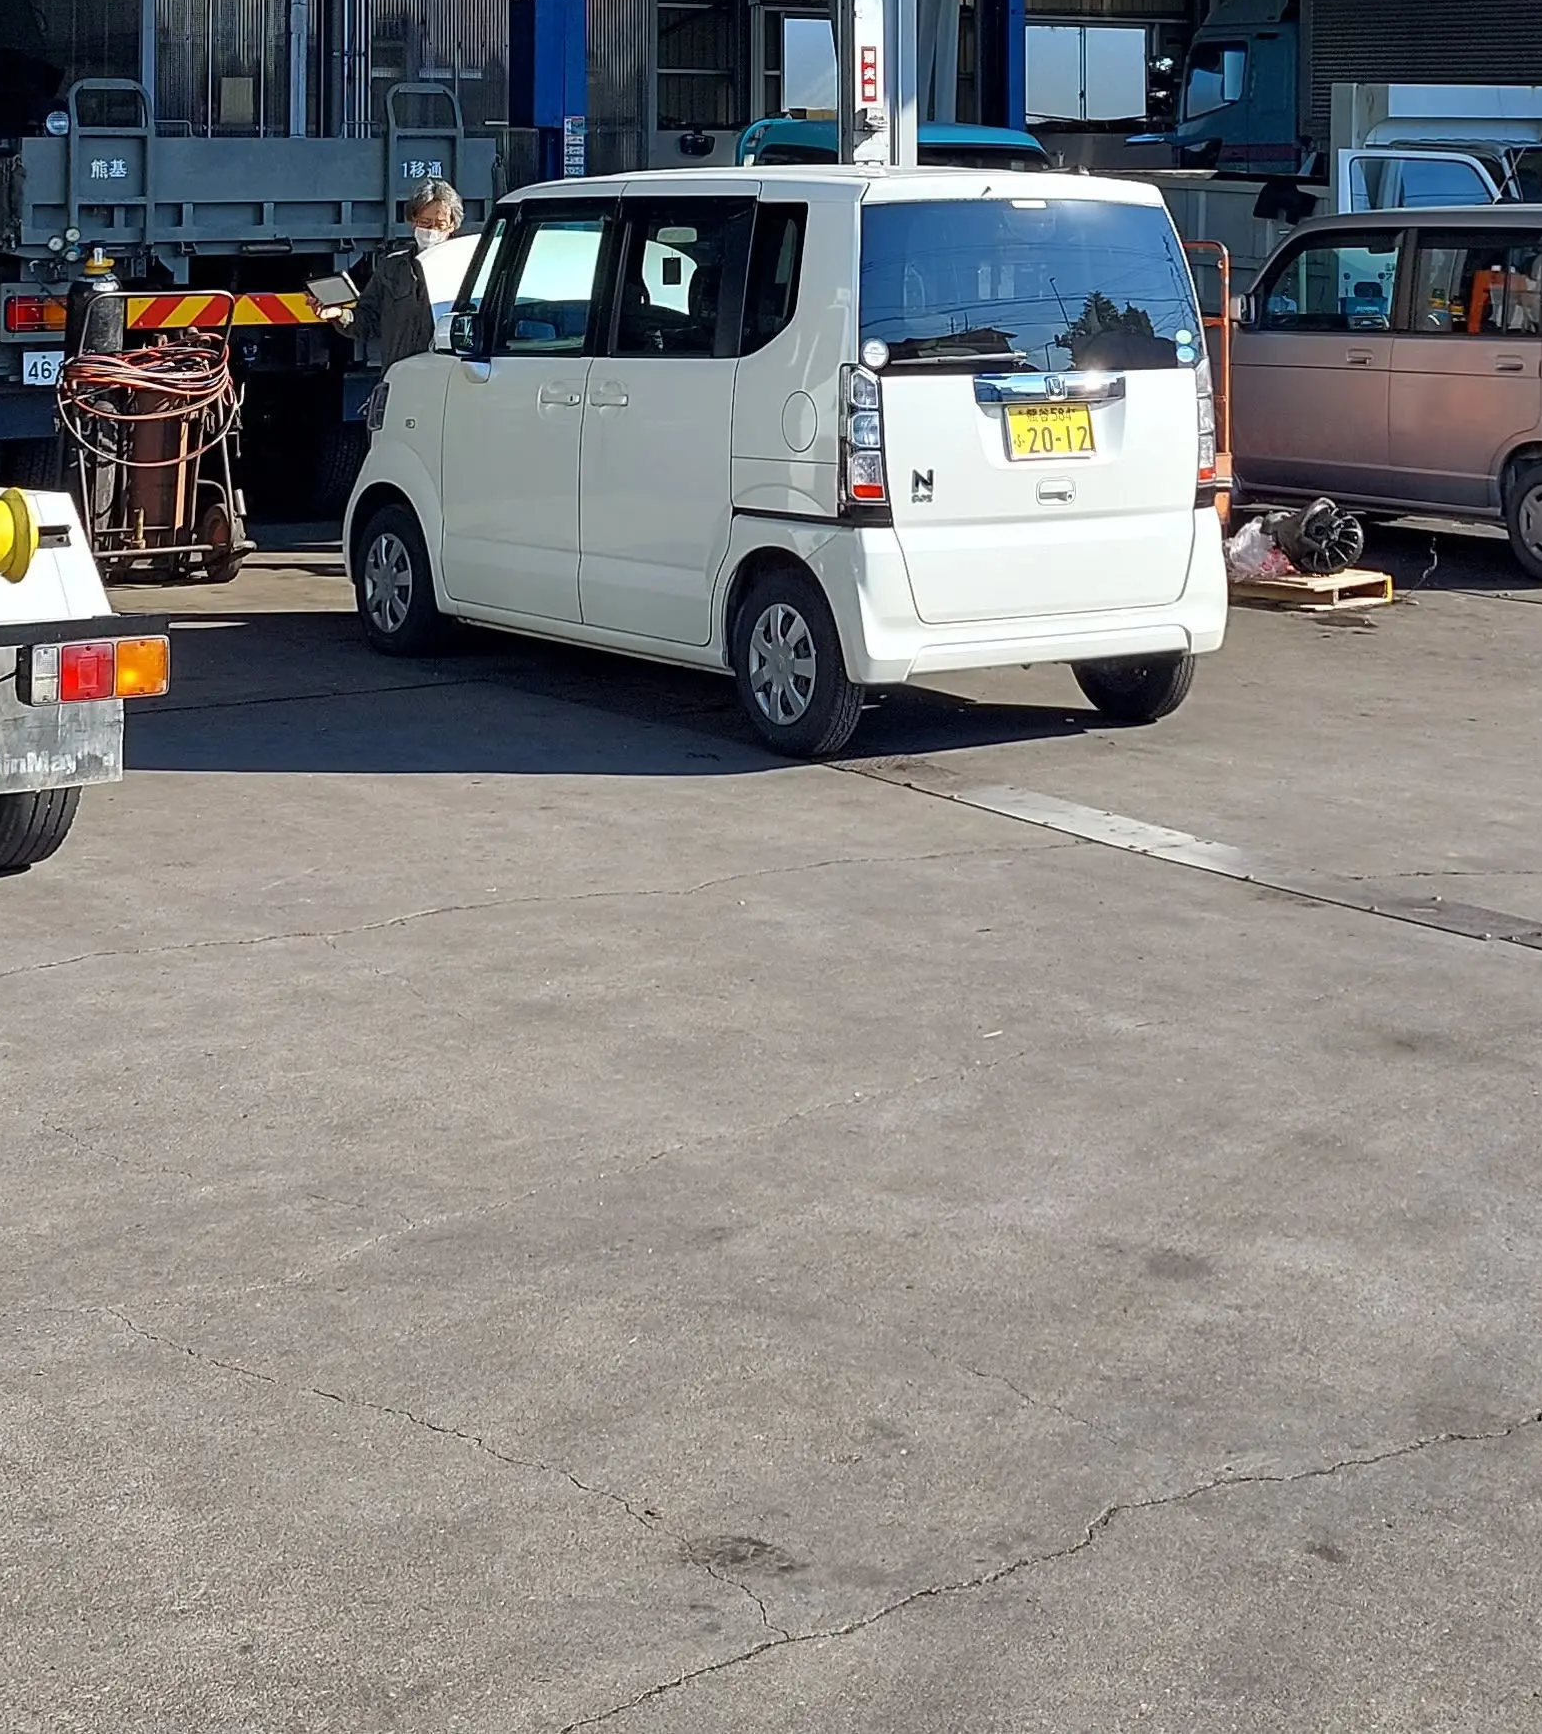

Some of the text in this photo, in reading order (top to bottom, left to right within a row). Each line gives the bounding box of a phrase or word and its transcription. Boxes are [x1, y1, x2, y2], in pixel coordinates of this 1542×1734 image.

[90, 159, 127, 179] 熊基
[401, 160, 443, 179] 1移通
[1027, 426, 1091, 453] 20-12
